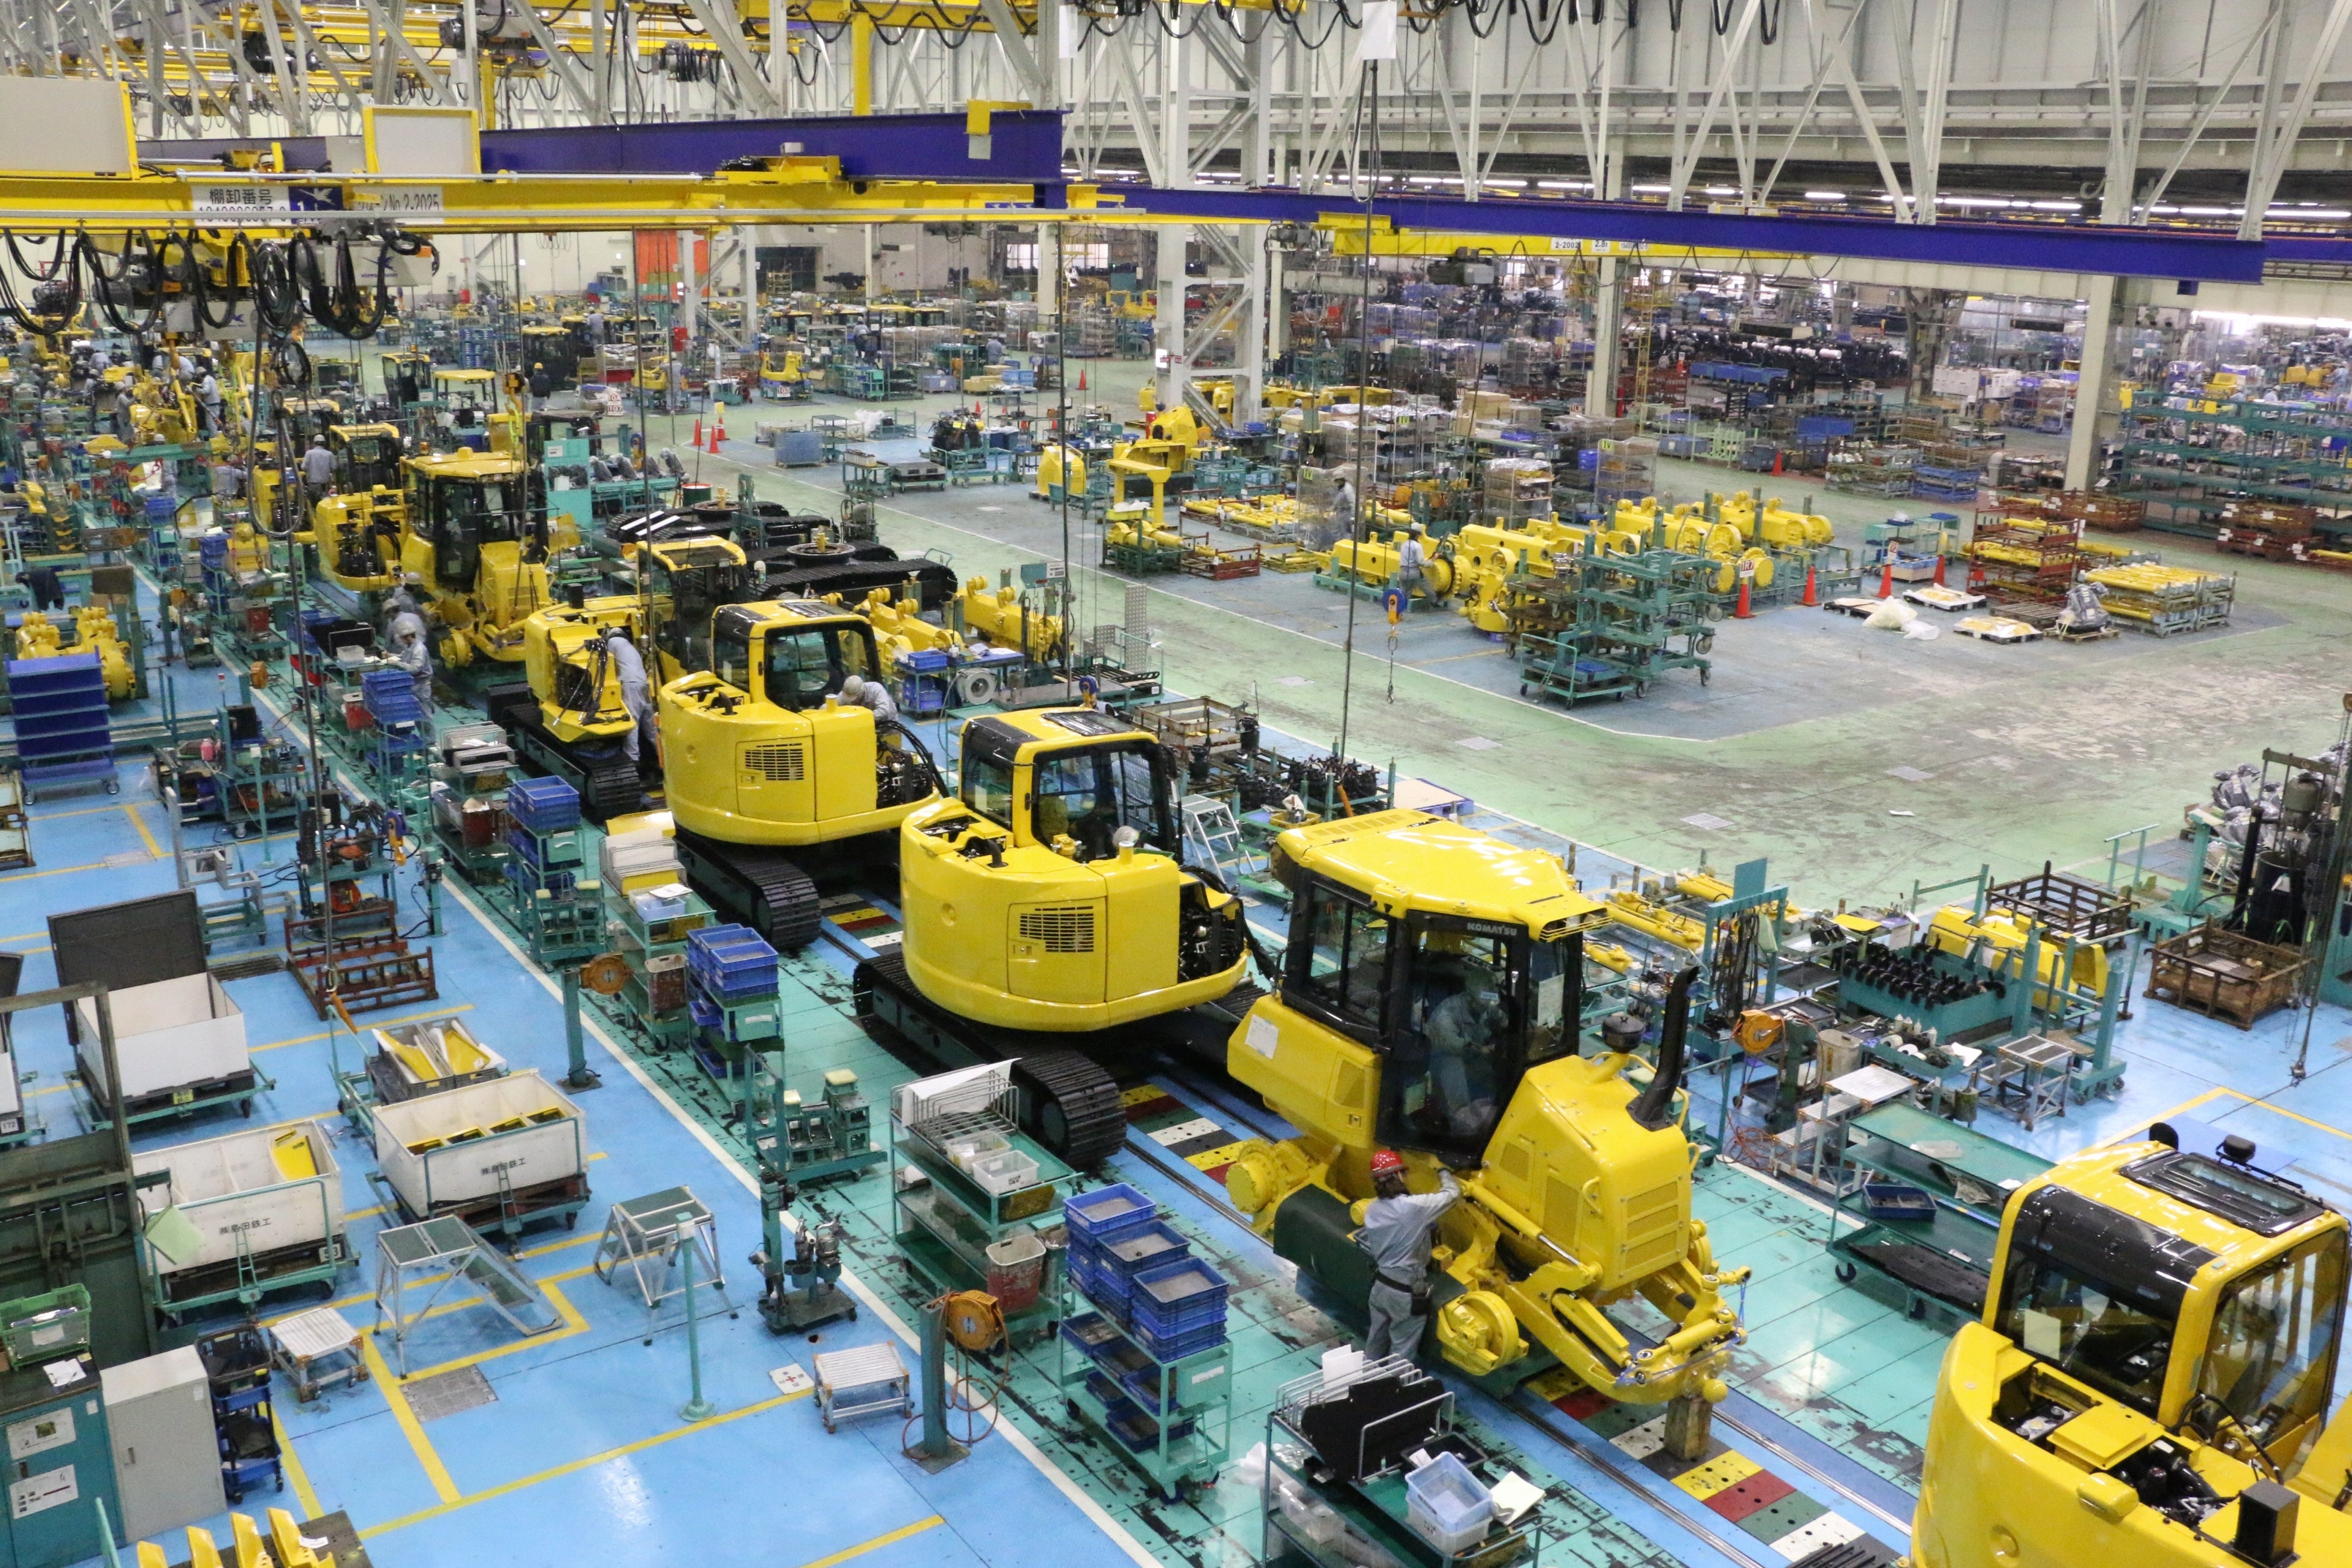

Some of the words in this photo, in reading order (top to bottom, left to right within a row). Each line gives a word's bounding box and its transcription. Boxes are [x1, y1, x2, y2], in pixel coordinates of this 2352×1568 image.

[210, 188, 272, 204] 棚卸番号
[1741, 560, 1754, 571] 1R7
[1467, 922, 1517, 936] KOMATSU
